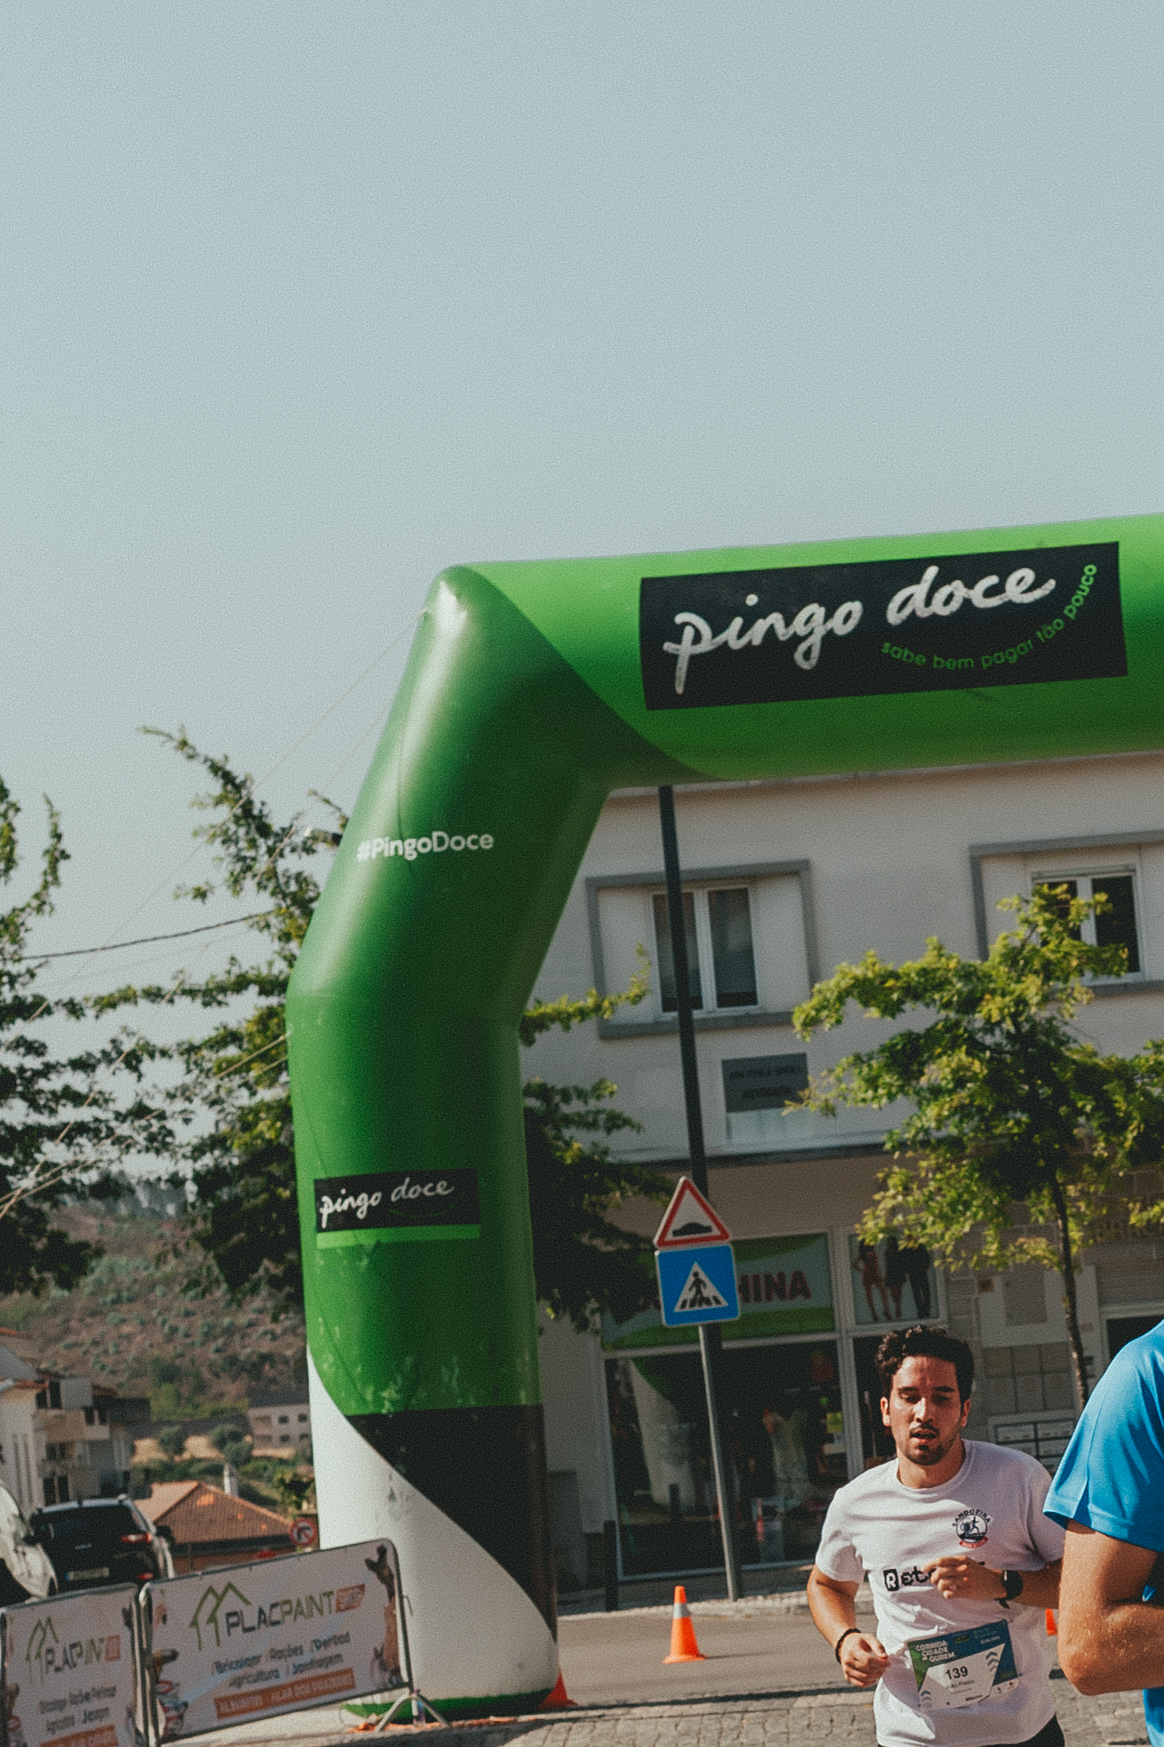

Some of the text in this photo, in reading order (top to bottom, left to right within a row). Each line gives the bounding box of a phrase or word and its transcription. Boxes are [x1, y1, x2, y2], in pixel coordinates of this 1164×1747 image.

[663, 565, 1056, 694] pingo doce
[881, 641, 926, 666] sabe
[932, 655, 975, 670] bem
[981, 639, 1033, 670] pagar
[1063, 564, 1097, 619] pouco
[357, 831, 494, 862] #PingoDoce
[319, 1188, 382, 1229] pingo
[391, 1177, 455, 1203] doce
[945, 1666, 969, 1680] 139
